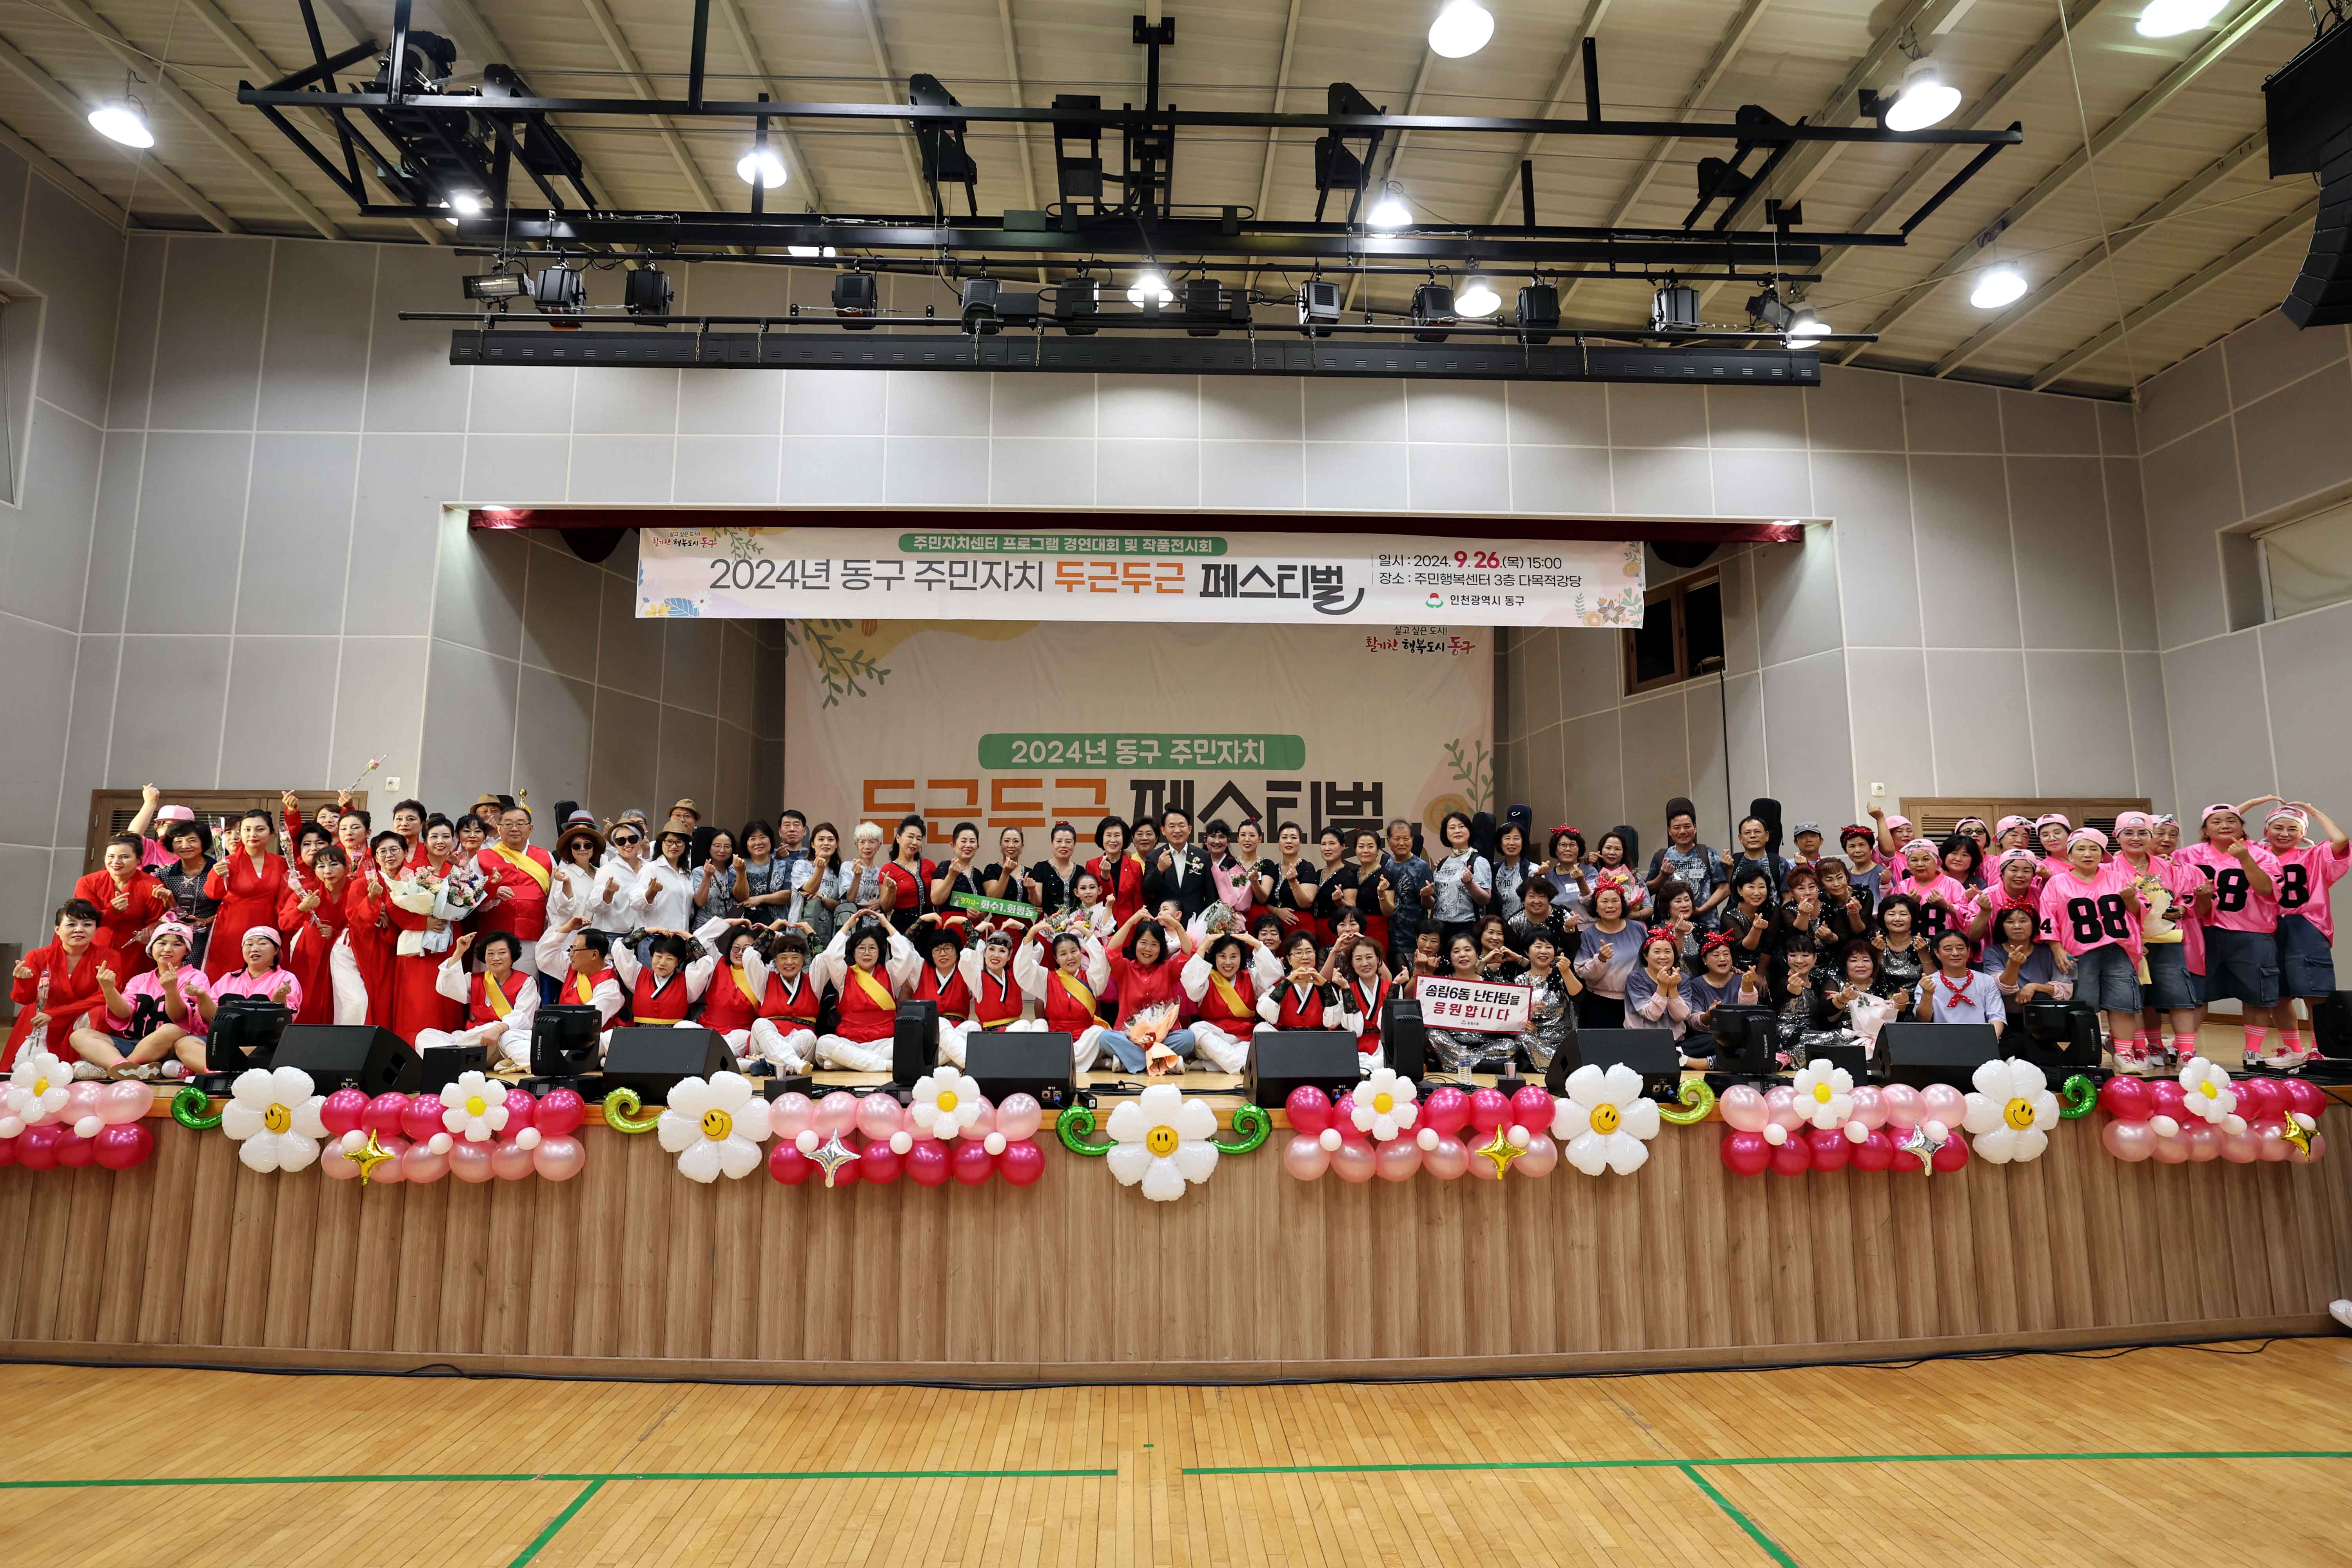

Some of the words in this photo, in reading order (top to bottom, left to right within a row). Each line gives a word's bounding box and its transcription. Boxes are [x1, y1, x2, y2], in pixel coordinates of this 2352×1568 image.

[673, 539, 699, 547] 행복도시
[700, 537, 717, 548] 동구
[914, 536, 998, 550] 주민자치센터
[1003, 537, 1060, 551] 프로그램
[1064, 538, 1120, 552] 경연대회
[1125, 539, 1138, 552] 및
[1143, 539, 1212, 553] 작품전시회
[1379, 554, 1403, 566] 일시
[1414, 555, 1451, 567] 2024.
[1528, 557, 1562, 570] 15:00
[710, 559, 830, 590] 2024년
[840, 560, 905, 591] 동구
[914, 561, 1043, 592] 주민자치
[1055, 561, 1185, 593] 두근두근
[1200, 564, 1365, 615] 페스티벌
[1379, 572, 1405, 584] 장소
[1414, 573, 1490, 586] 주민행복센터
[1494, 574, 1515, 586] 3층
[1519, 574, 1582, 587] 다목적강당
[1450, 594, 1501, 606] 인천광역시
[1505, 595, 1524, 606] 동구
[1394, 626, 1410, 635] 살고
[1412, 627, 1427, 635] 싶은
[1429, 627, 1447, 635] 도시!
[1366, 637, 1398, 652] 활기찬
[1402, 639, 1445, 654] 행복도시
[1447, 637, 1475, 655] 동구
[1011, 740, 1107, 764] 2024년
[1116, 740, 1161, 764] 동구
[1170, 739, 1264, 765] 주민자치
[860, 779, 1111, 844] 두근두근
[2068, 894, 2130, 944] 88
[1426, 985, 1471, 1000] 송림6동
[1474, 990, 1520, 1005] 난타팀을
[1434, 1002, 1509, 1021] 응원합니다
